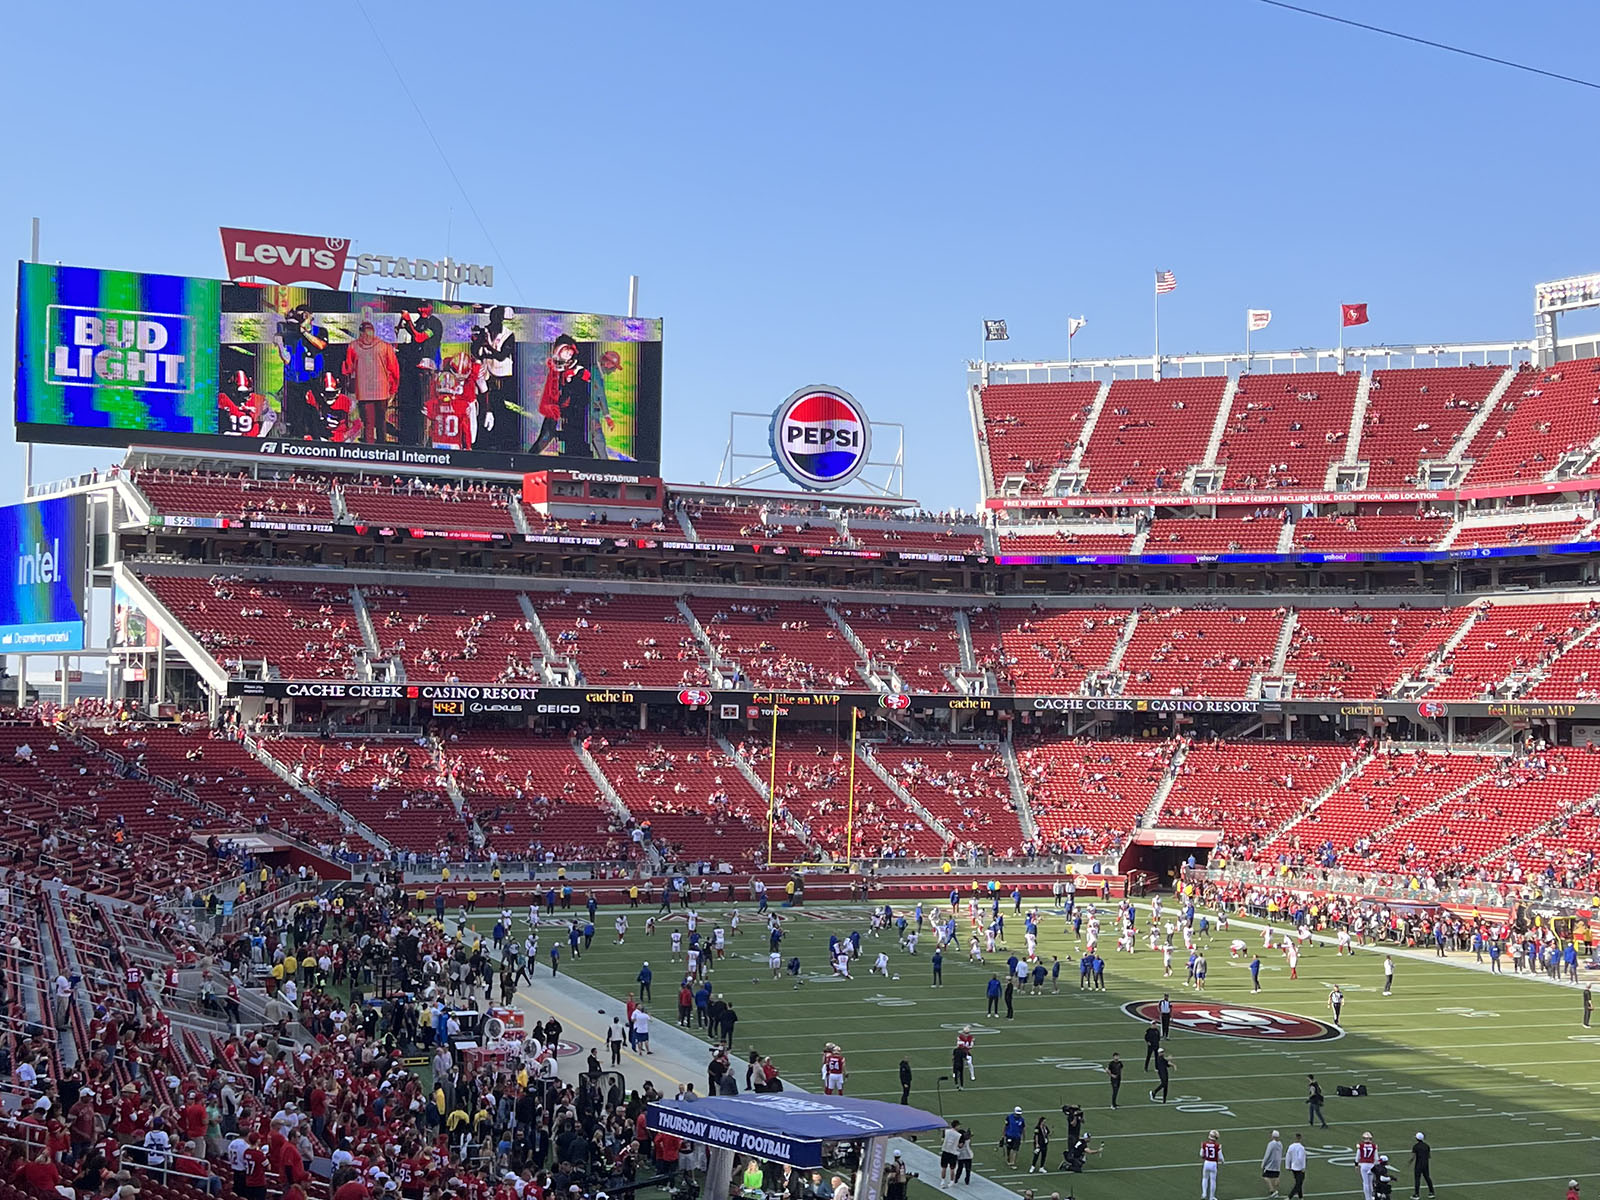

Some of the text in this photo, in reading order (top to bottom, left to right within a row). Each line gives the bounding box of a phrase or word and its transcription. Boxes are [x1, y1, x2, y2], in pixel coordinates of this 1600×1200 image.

[357, 253, 493, 287] STADIUM
[74, 315, 168, 351] BUD
[54, 346, 185, 384] LIGHT
[436, 415, 459, 436] 10
[787, 426, 858, 447] PEPSI
[281, 443, 337, 457] Foxconn
[340, 447, 400, 461] Industrial
[402, 452, 450, 464] Internet
[604, 474, 638, 484] STADIUM
[1086, 498, 1129, 506] ASSISTANCE?
[1401, 492, 1439, 500] LOCATION.
[250, 521, 286, 530] MOUNTAIN
[288, 522, 311, 531] MIKE'S
[313, 523, 333, 532] PIZZA
[525, 534, 600, 545] MOUNTAIN MIKE'S PIZZA
[663, 541, 694, 549] MOUNTAIN
[695, 543, 716, 551] MIKE'S
[717, 544, 735, 552] PIZZA
[899, 553, 927, 561] MOUNTAIN
[948, 554, 965, 563] PIZZA
[286, 684, 538, 700] CACHE CREEK CASINO RESORT
[586, 690, 634, 704] cache in
[753, 694, 840, 705] feel like an MVP
[949, 697, 990, 709] cache in
[1033, 699, 1083, 710] CACHE
[1086, 700, 1133, 710] CREEK
[1151, 701, 1203, 711] CASINO
[1206, 702, 1260, 712] RESORT
[483, 704, 522, 712] LEXUS
[537, 705, 580, 714] GEICO
[1341, 703, 1384, 716] cache in
[1488, 704, 1576, 716] feel like an MVP
[127, 972, 138, 983] 16
[658, 1111, 791, 1160] THURSDAY NIGHT FOOTBALL
[1205, 1147, 1215, 1158] 13
[1363, 1147, 1373, 1158] 17
[871, 1144, 883, 1182] NIGHT
